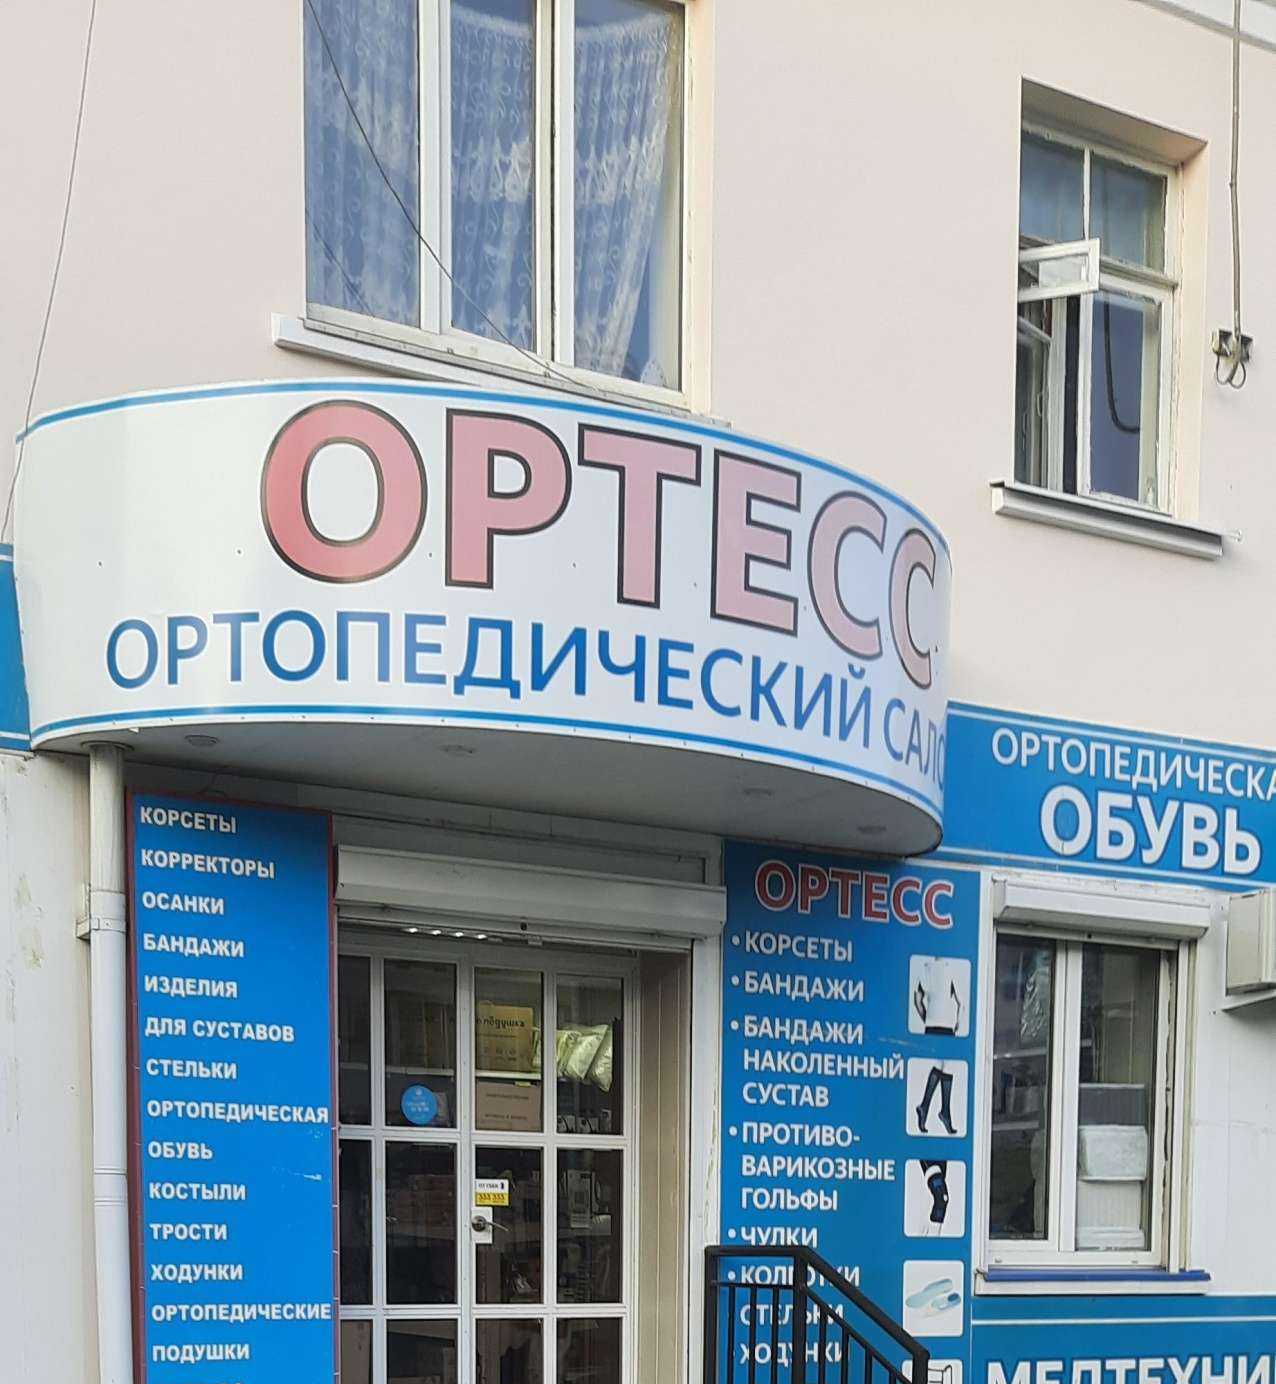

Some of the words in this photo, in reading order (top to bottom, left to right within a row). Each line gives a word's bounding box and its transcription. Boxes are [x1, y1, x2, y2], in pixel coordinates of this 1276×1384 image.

[260, 399, 938, 690] ОРТЕСС
[106, 609, 873, 750] ОРТОПЕДИЧЕСКИЙ
[140, 806, 237, 834] КОРСЕТЫ
[1040, 784, 1261, 875] ОБУВЬ
[141, 849, 275, 879] КОРРЕКТОРЫ
[142, 891, 225, 915] ОСАНКИ
[755, 860, 954, 930] ОРТЕСС
[143, 933, 244, 958] БАНДАЖИ
[745, 930, 853, 962] КОРСЕТЫ
[144, 975, 238, 999] ИЗДЕЛИЯ
[744, 971, 864, 1002] БАНДАЖИ
[145, 1016, 186, 1036] ДЛЯ
[192, 1020, 294, 1042] СУСТАВОВ
[743, 1015, 863, 1045] БАНДАЖИ
[146, 1058, 237, 1080] СТЕЛЬКИ
[743, 1048, 904, 1080] НАКОЛЕННЫЙ
[742, 1082, 829, 1108] СУСТАВ
[147, 1099, 329, 1124] ОРТОПЕДИЧЕСКАЯ
[742, 1121, 860, 1147] ПРОТИВО-
[148, 1141, 213, 1160] ОБУВЬ
[741, 1154, 895, 1181] ВАРИКОЗНЫЕ
[149, 1182, 246, 1201] КОСТЫЛИ
[741, 1187, 838, 1212] ГОЛЬФЫ
[150, 1223, 228, 1241] ТРОСТИ
[740, 1226, 818, 1248] ЧУЛКИ
[151, 1264, 243, 1283] ХОДУНКИ
[151, 1303, 332, 1323] ОРТОПЕДИЧЕСКИЕ
[152, 1344, 250, 1363] ПОДУШКИ
